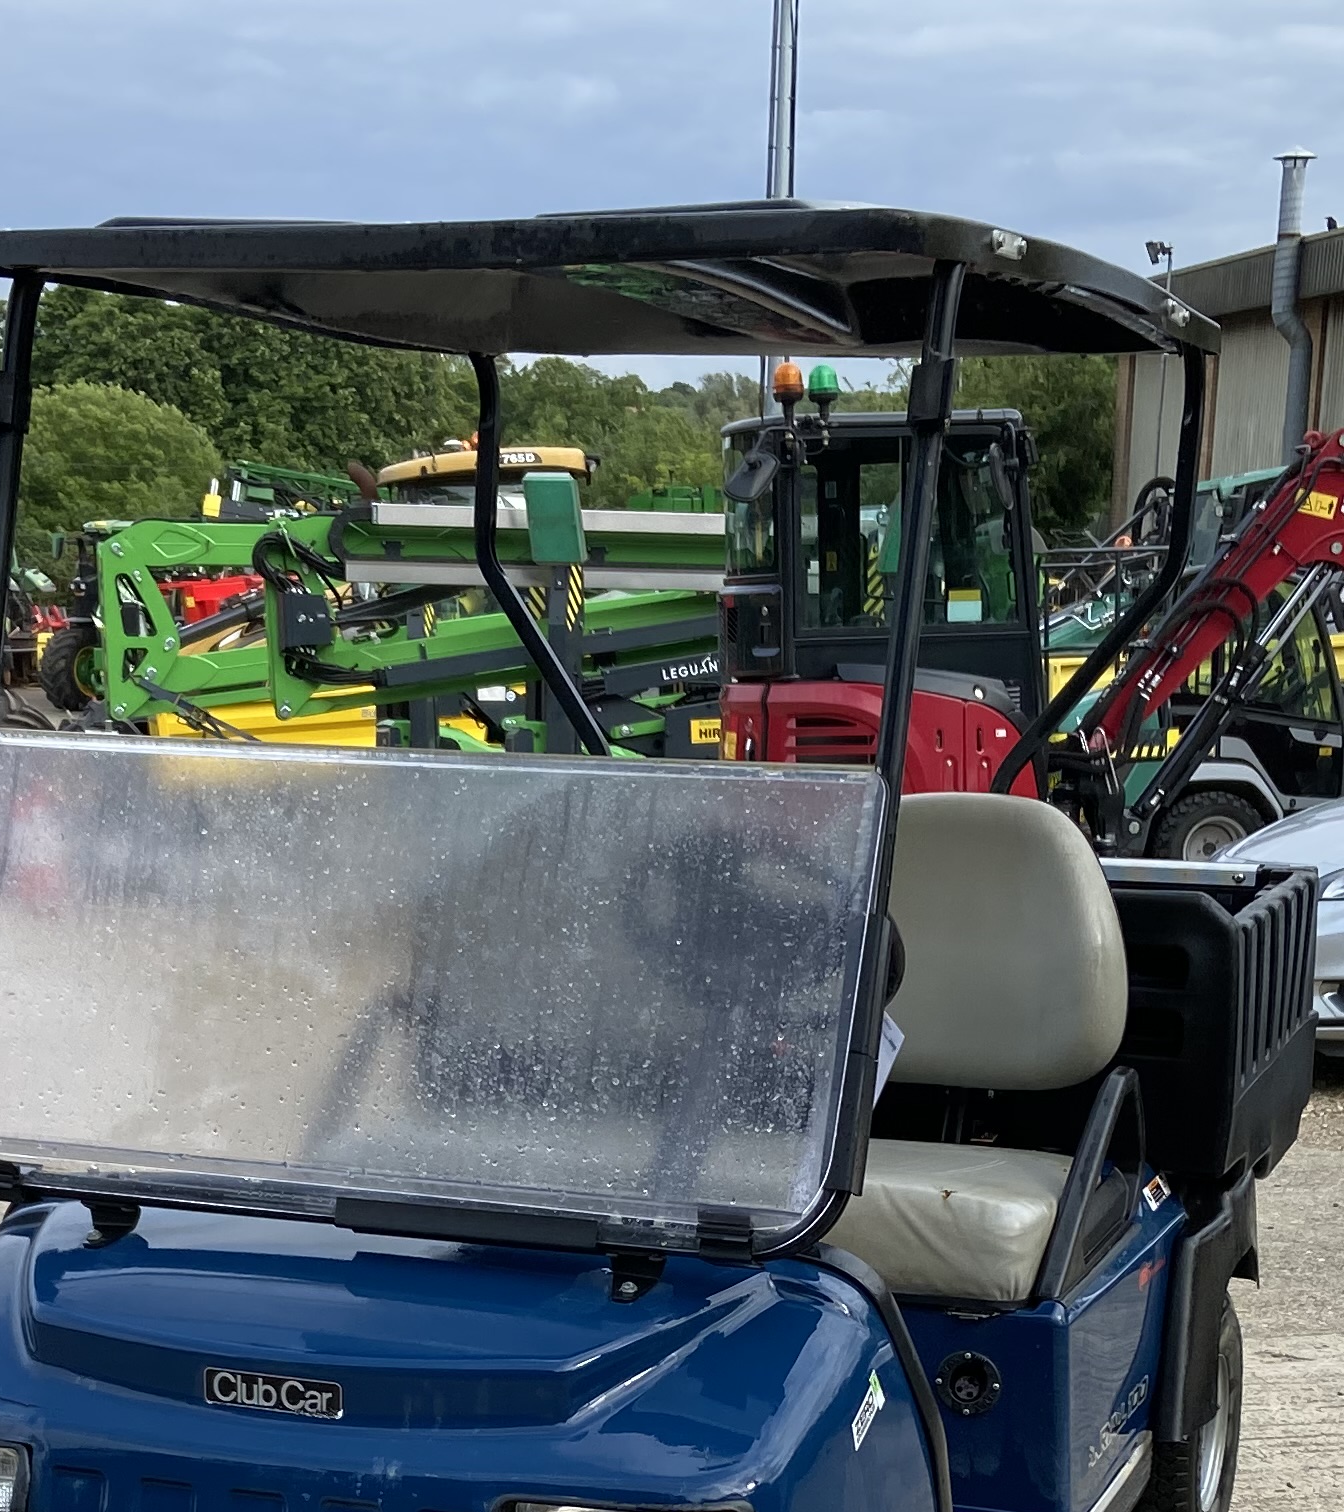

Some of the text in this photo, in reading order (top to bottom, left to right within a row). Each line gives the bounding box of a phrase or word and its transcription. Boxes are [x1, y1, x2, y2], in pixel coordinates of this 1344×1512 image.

[500, 452, 536, 464] 765D
[661, 655, 719, 681] LEGUAN
[212, 1371, 333, 1413] Club Car
